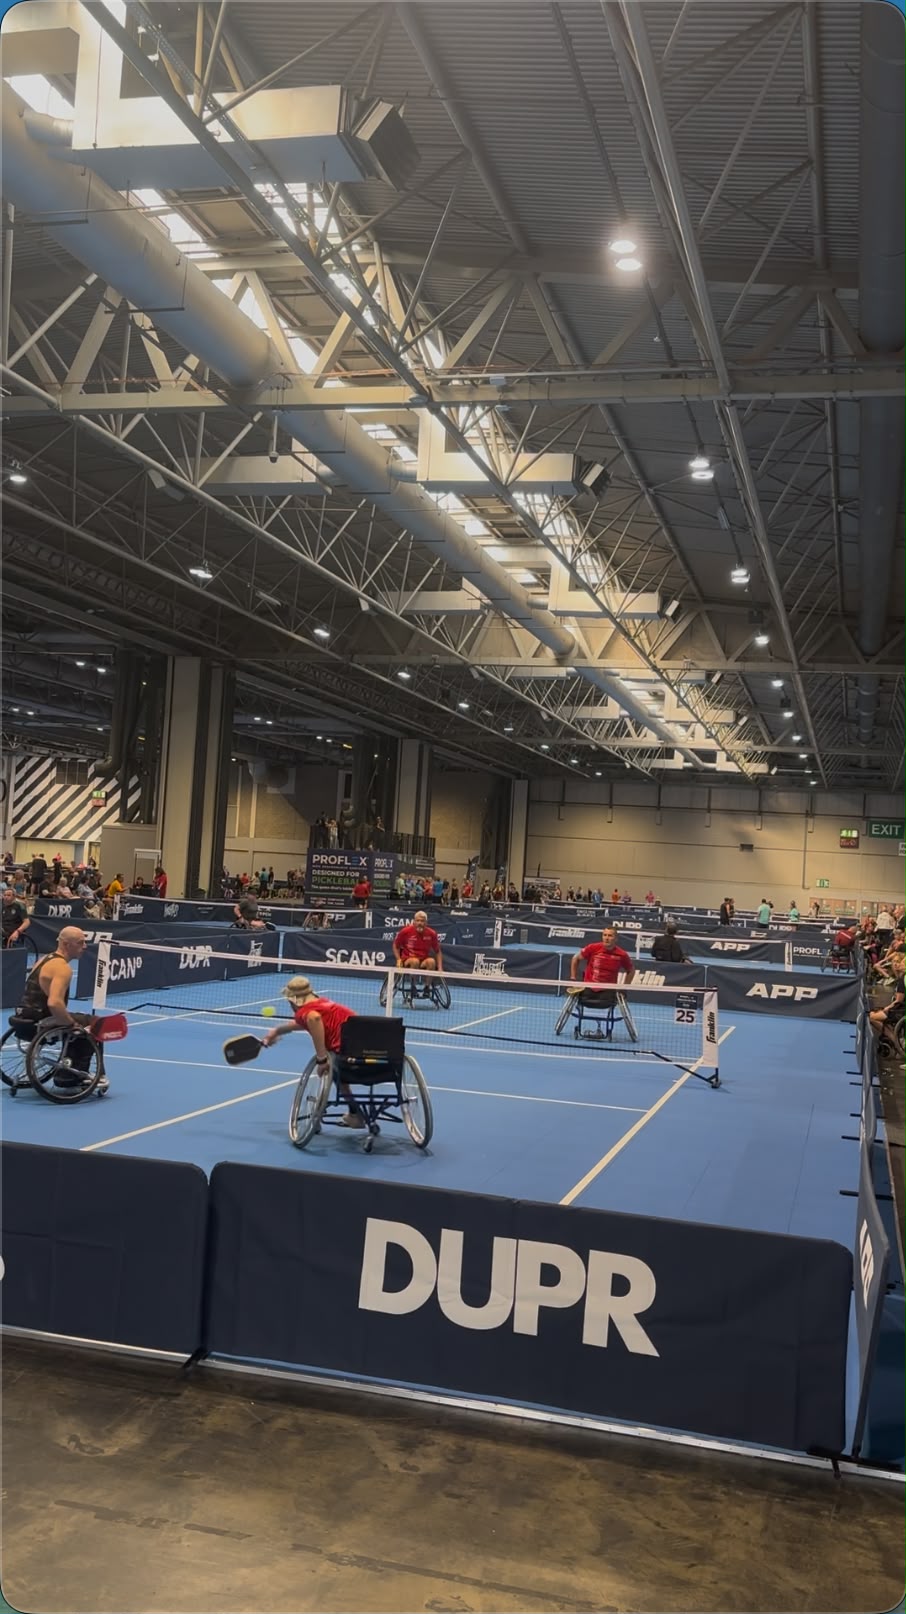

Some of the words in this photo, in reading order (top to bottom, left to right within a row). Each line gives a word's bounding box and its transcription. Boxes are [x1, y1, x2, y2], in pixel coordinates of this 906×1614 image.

[872, 824, 901, 836] EXIT
[48, 904, 72, 918] DUPR
[710, 941, 751, 952] APP
[179, 945, 213, 969] DUPR
[97, 959, 106, 988] Franklin
[745, 982, 819, 1001] APP
[676, 1010, 695, 1023] 25
[706, 1011, 717, 1044] Franklin
[358, 1217, 660, 1357] DUPR
